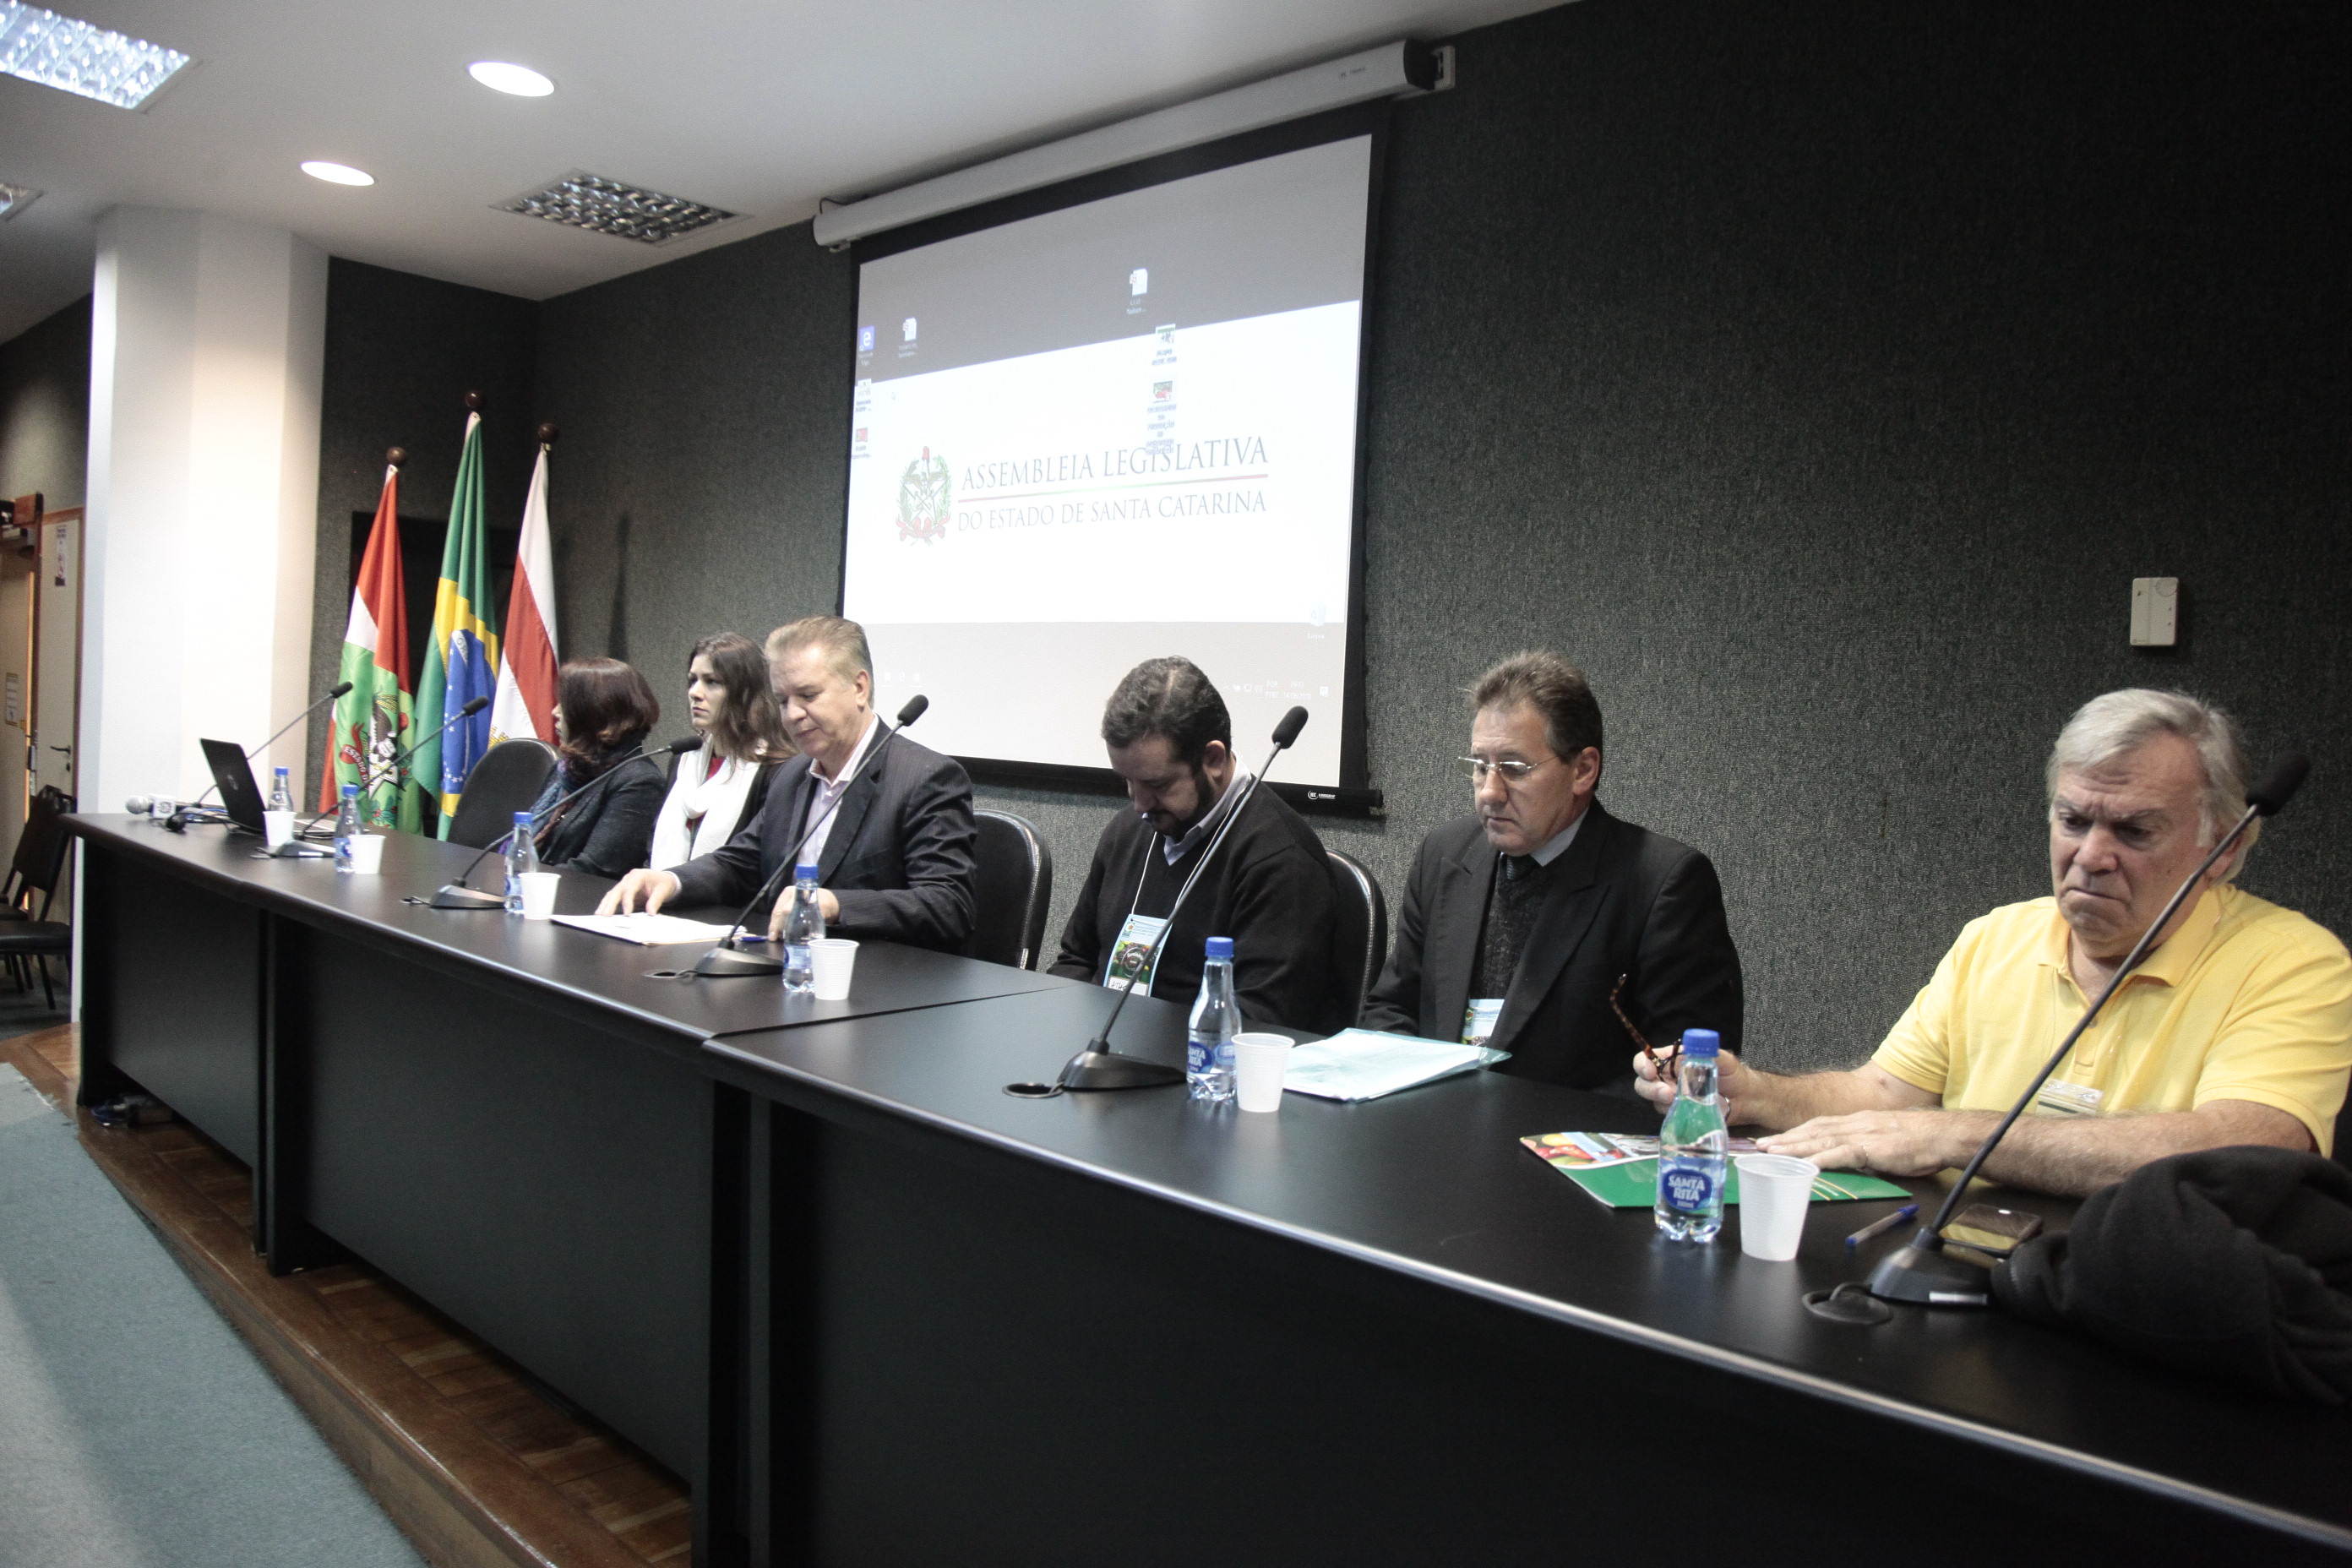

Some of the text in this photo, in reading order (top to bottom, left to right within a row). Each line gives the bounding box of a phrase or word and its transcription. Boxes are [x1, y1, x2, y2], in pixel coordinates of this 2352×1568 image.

[961, 435, 1269, 492] ASSEMBLEIA LEGISLATIVA
[958, 490, 1266, 531] DO ESTADO DE SANTA CATARINA
[344, 746, 367, 772] ESTADO
[1668, 1175, 1706, 1191] SANTA
[1673, 1187, 1701, 1201] RITA
